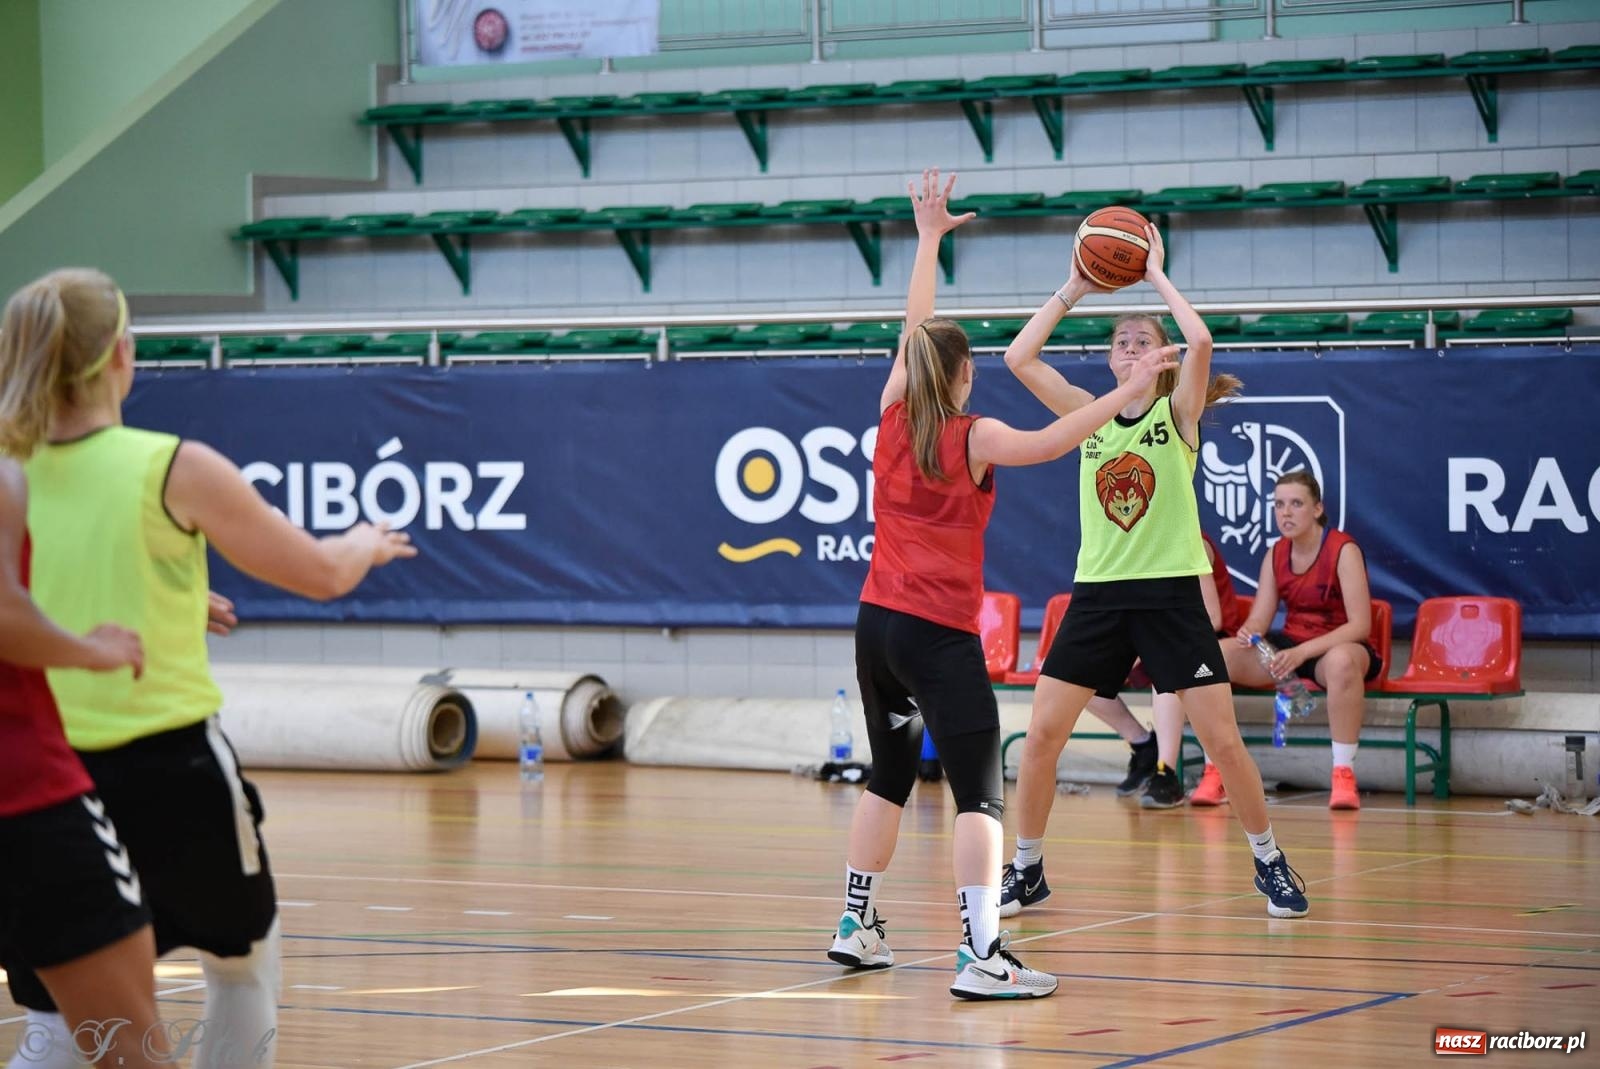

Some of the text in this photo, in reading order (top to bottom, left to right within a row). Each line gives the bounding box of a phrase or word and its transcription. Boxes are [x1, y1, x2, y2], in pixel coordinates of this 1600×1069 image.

[1091, 260, 1138, 284] molten
[1139, 421, 1170, 447] 45
[1448, 457, 1600, 534] RA
